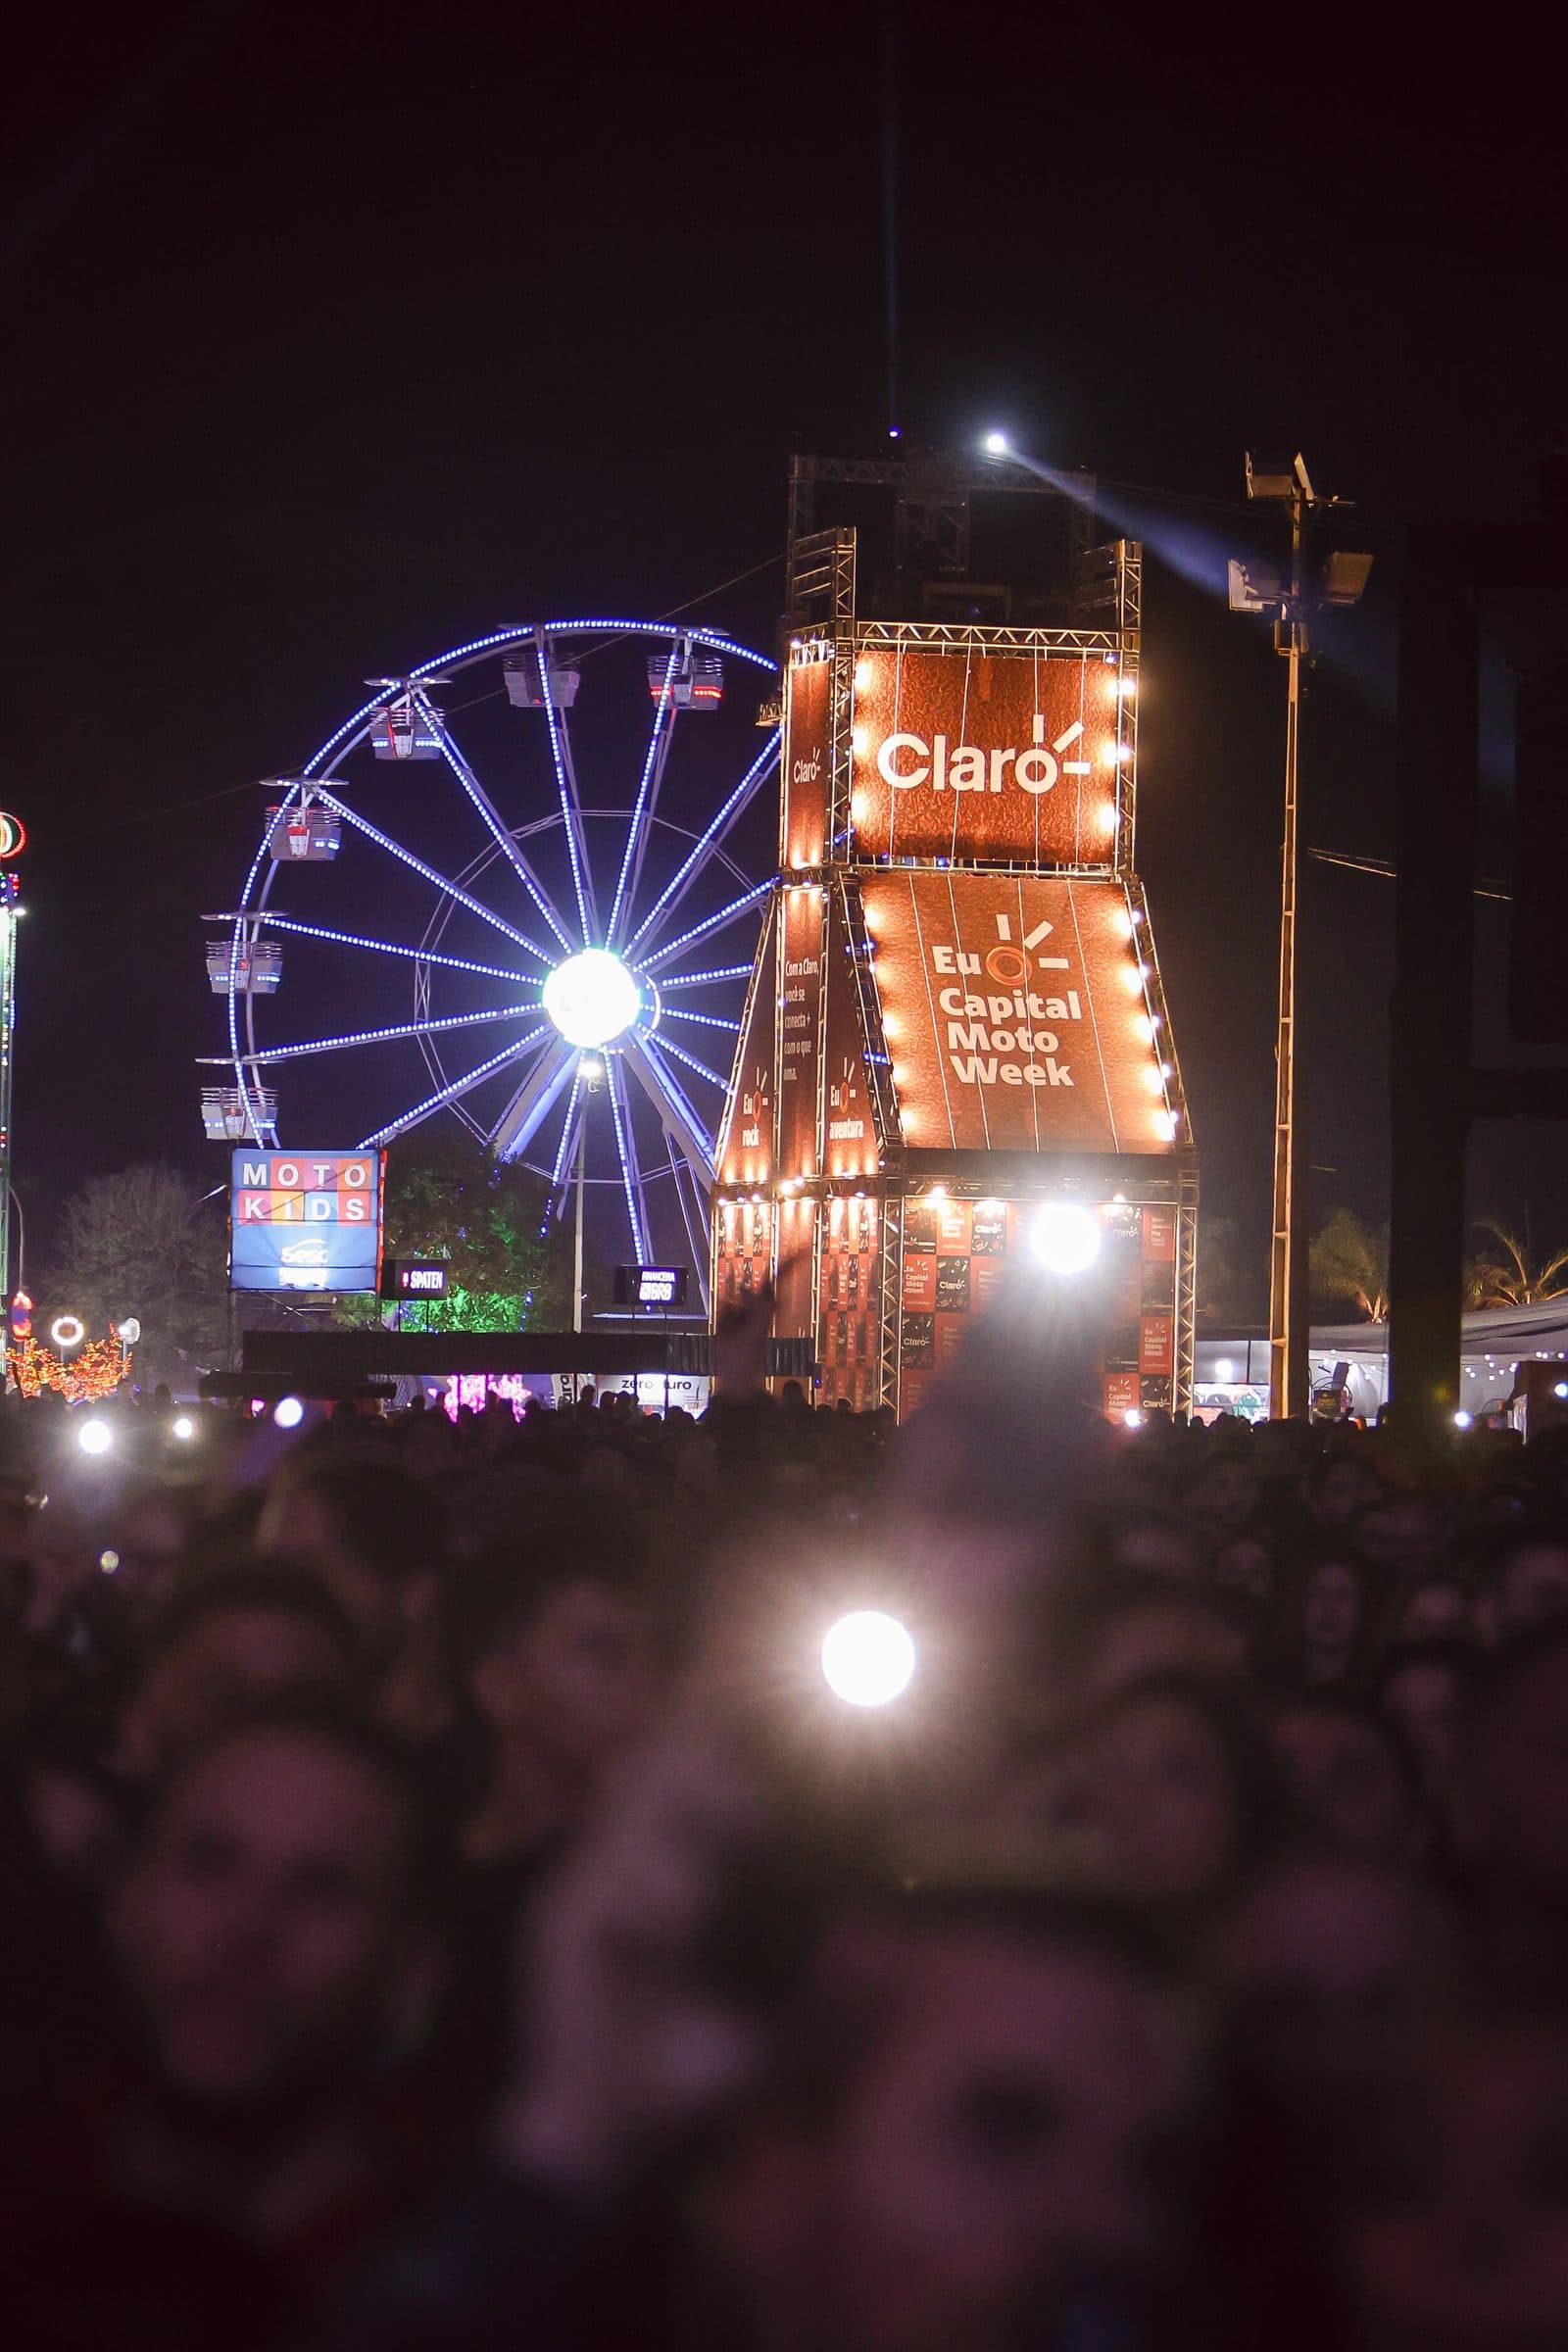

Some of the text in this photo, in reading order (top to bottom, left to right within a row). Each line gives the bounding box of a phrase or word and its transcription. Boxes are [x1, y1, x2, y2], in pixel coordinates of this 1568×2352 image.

[793, 760, 816, 784] Claro
[877, 733, 1058, 794] Claro
[785, 960, 799, 977] Com
[932, 946, 982, 975] Eu
[939, 987, 1082, 1025] Capital
[947, 1021, 1058, 1053] Moto
[949, 1055, 1074, 1087] Week
[743, 1093, 753, 1114] Eu
[830, 1085, 840, 1106] Eu
[742, 1123, 760, 1147] rock
[829, 1117, 863, 1140] aventura
[243, 1163, 367, 1188] MOTO
[245, 1197, 366, 1221] KIDS
[411, 1270, 443, 1290] SPATEN
[663, 1379, 692, 1391] uro
